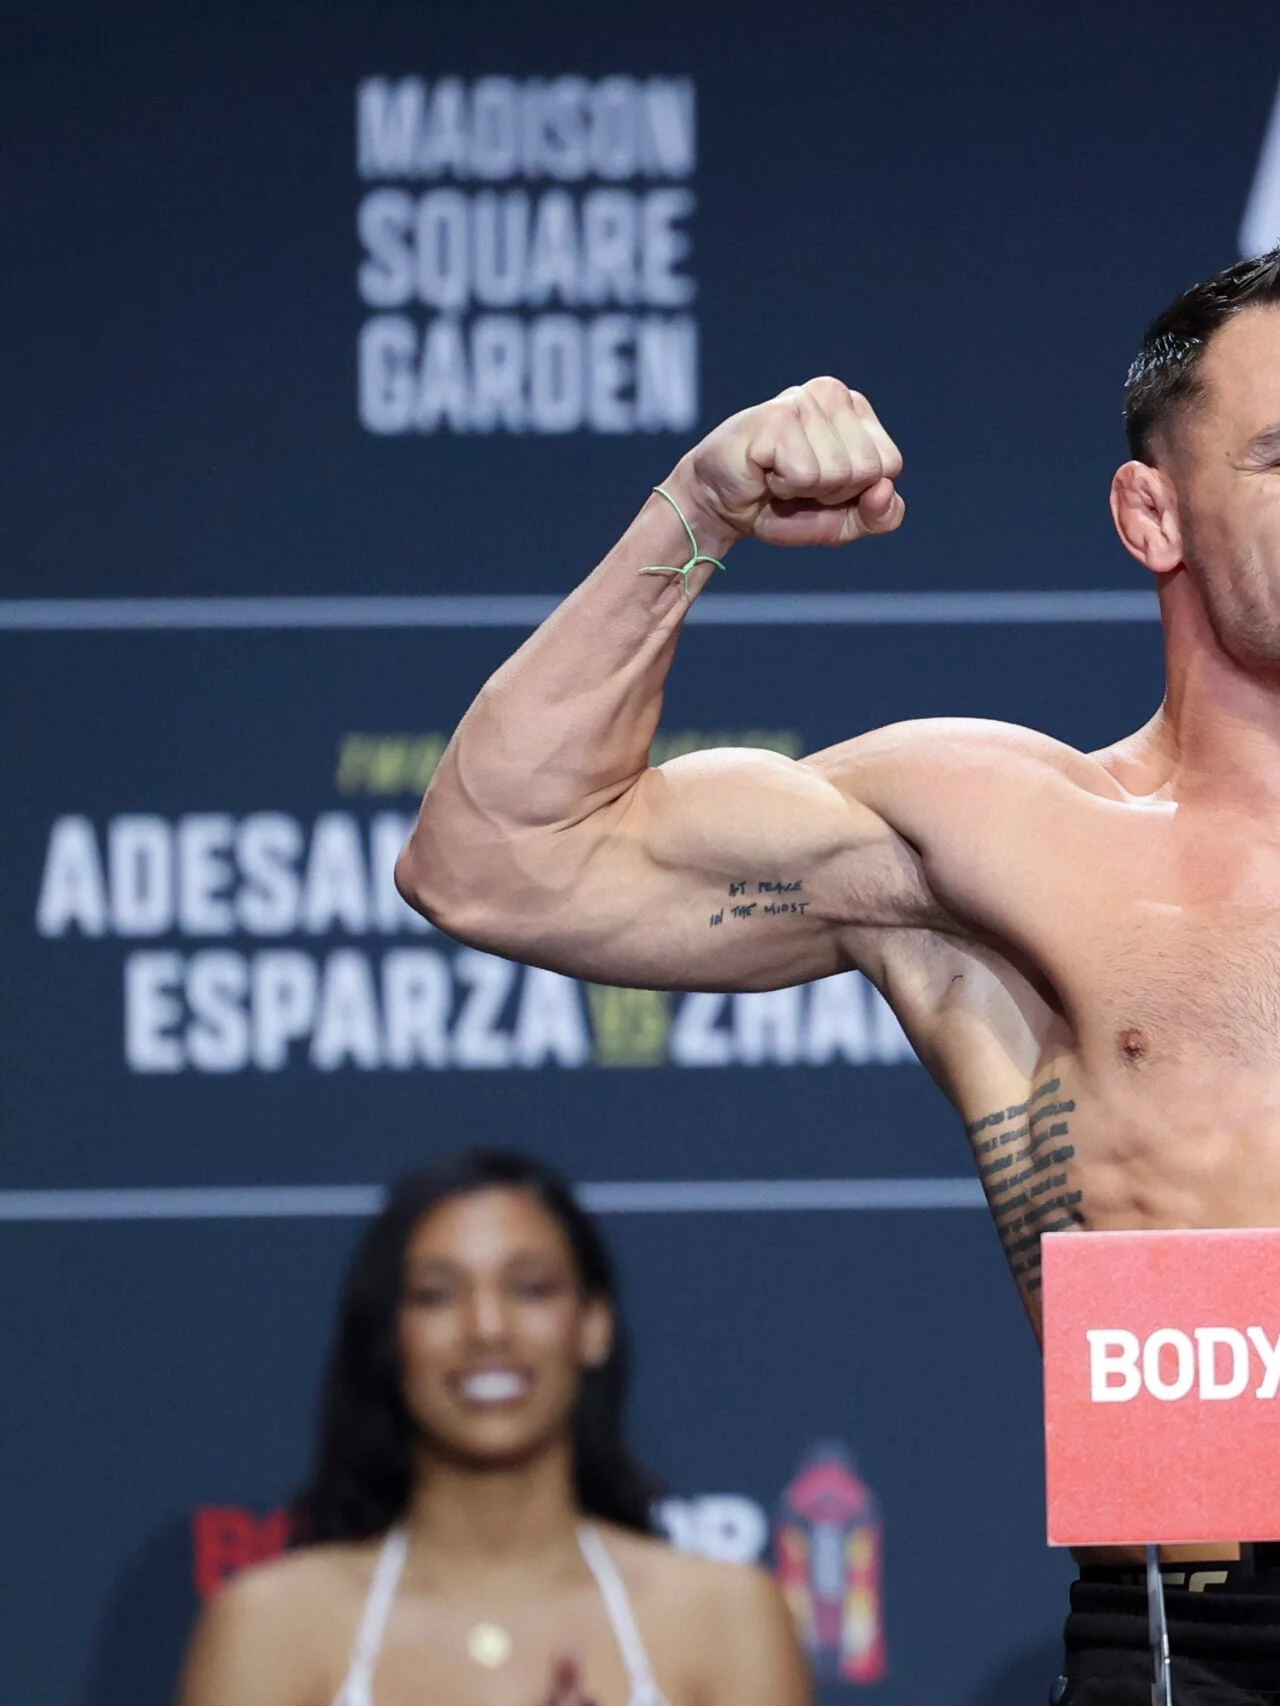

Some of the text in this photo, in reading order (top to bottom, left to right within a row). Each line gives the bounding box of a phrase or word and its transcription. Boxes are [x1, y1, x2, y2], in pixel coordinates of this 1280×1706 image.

[357, 75, 697, 178] MADISON
[357, 188, 697, 310] SQUARE
[357, 314, 699, 434] GARDEN
[731, 902, 757, 919] THE
[764, 902, 810, 915] MIDST
[124, 948, 594, 1074] ESPARZA
